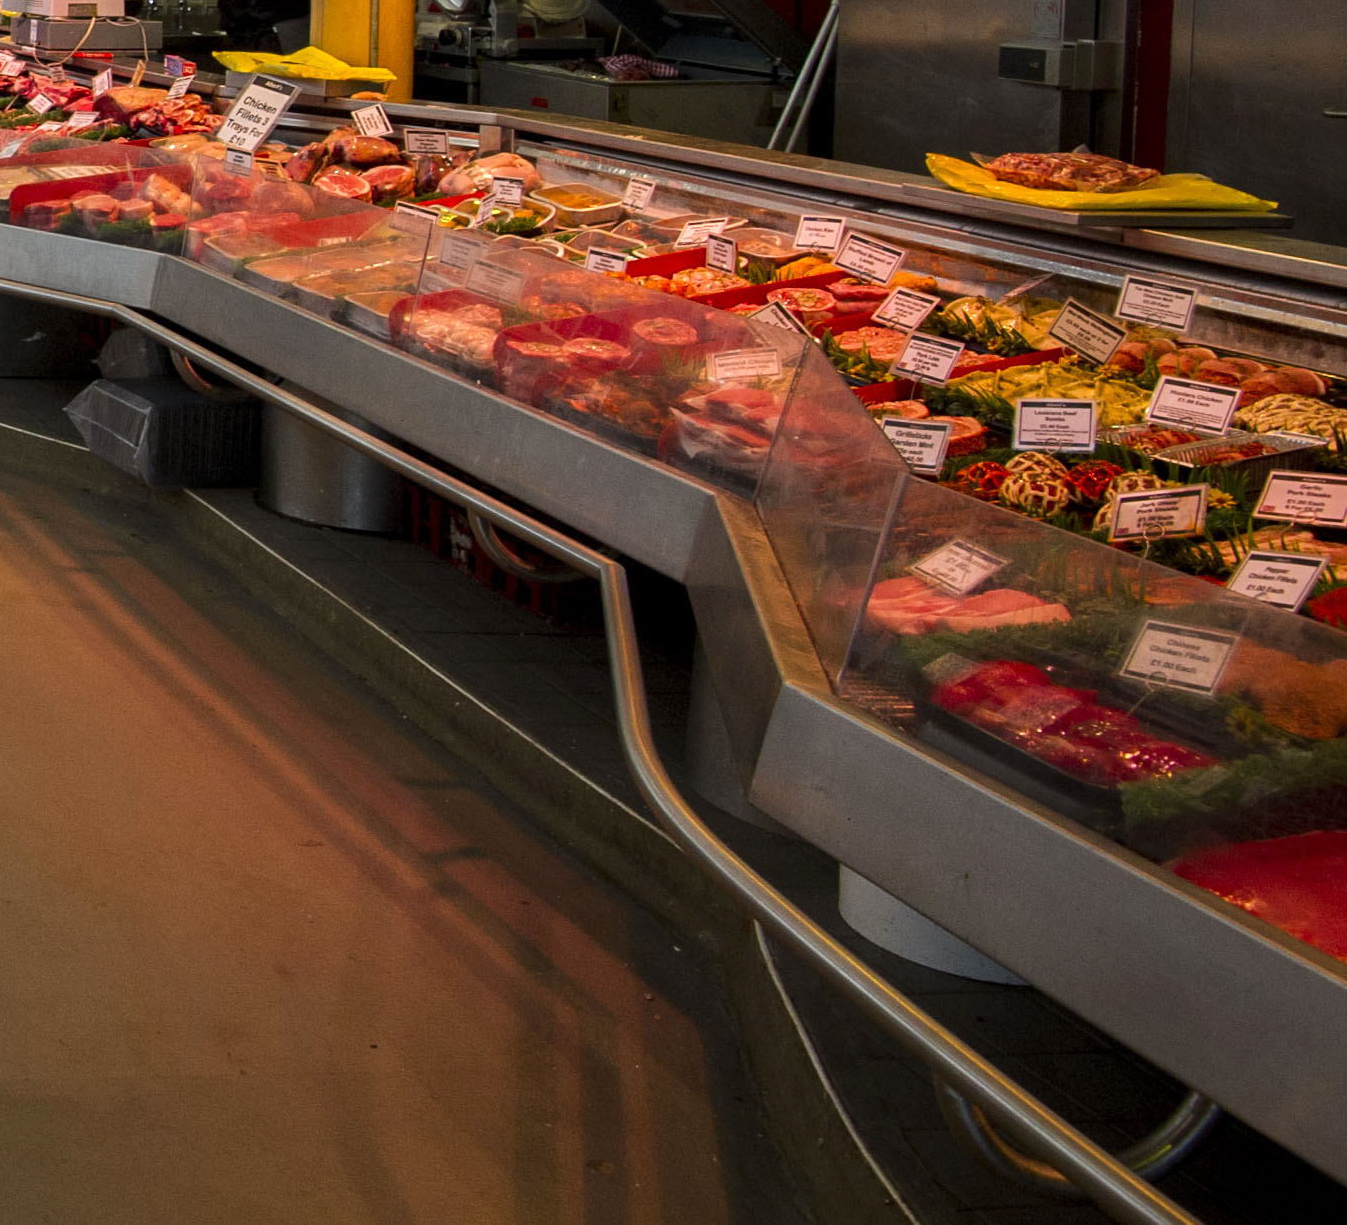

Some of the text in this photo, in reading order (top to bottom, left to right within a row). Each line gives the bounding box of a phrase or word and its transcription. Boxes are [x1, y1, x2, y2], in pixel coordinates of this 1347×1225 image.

[243, 96, 278, 115] Chicken
[236, 107, 270, 126] Fillets 3
[227, 118, 265, 138] Trays For
[228, 135, 247, 146] £10
[895, 430, 932, 440] Grillsticks
[916, 439, 935, 449] Mint
[1264, 566, 1291, 575] Pepper
[1248, 572, 1298, 585] Chicken Fillets
[1266, 586, 1285, 595] Each
[1166, 638, 1201, 652] Chinese
[1149, 644, 1183, 659] Chicken
[1175, 663, 1197, 674] Each
